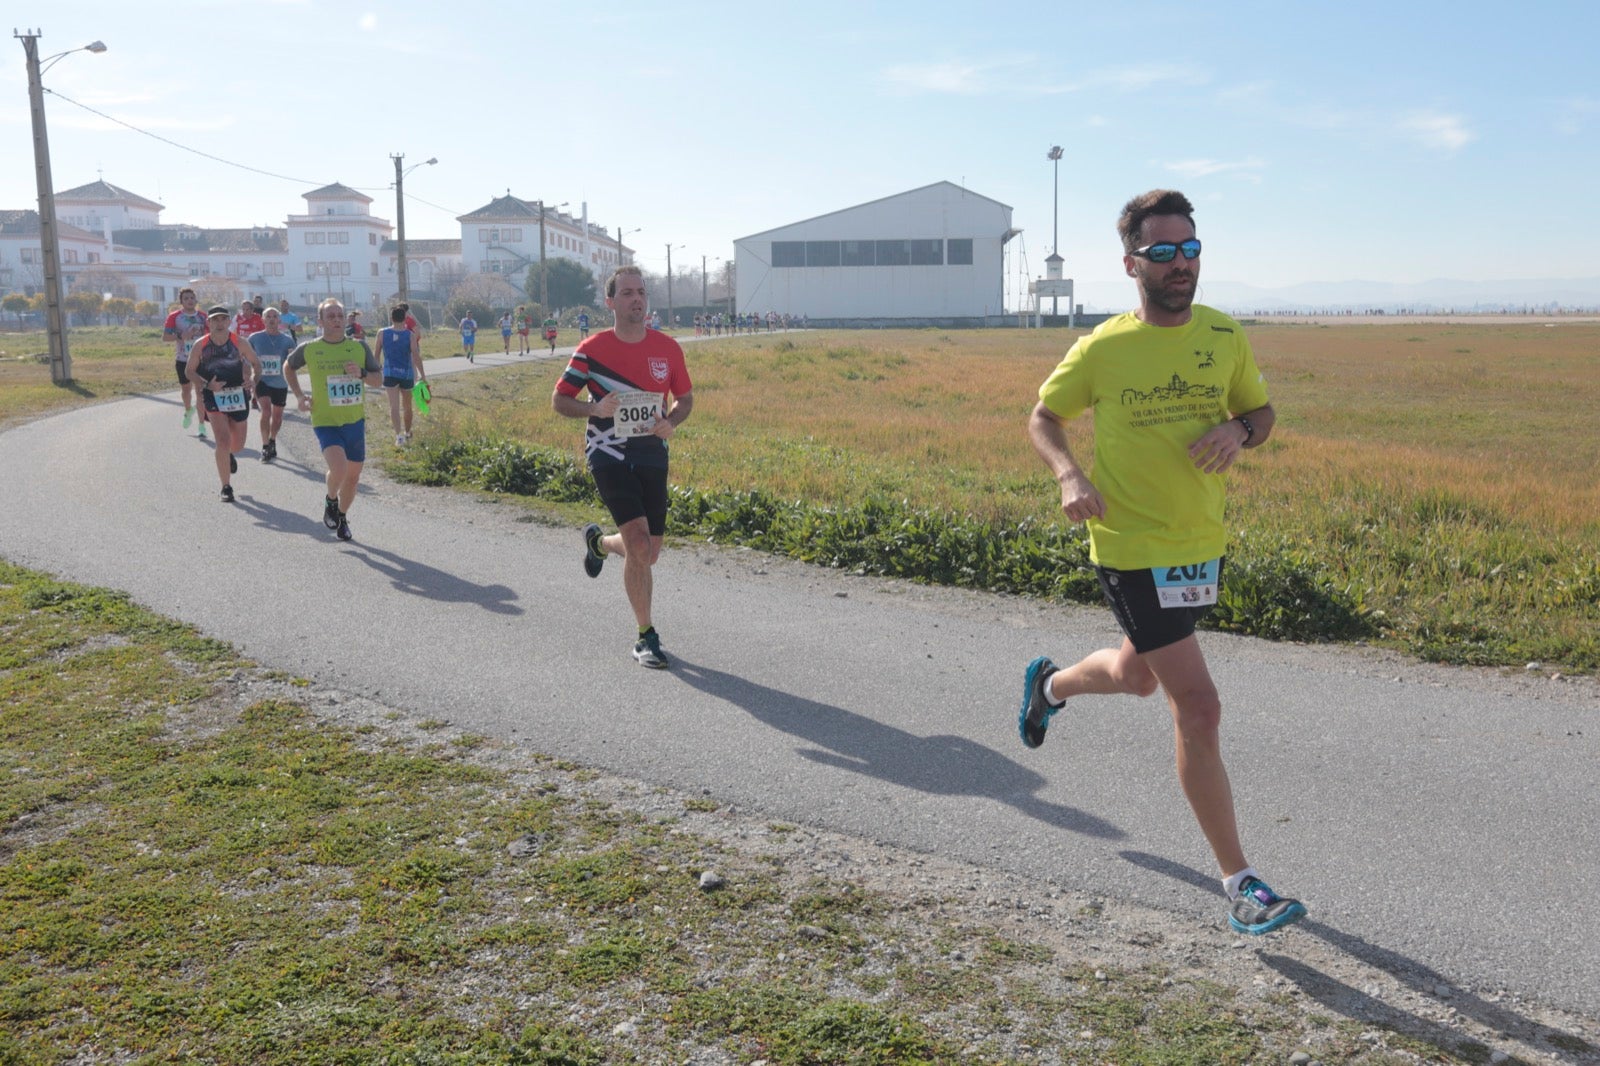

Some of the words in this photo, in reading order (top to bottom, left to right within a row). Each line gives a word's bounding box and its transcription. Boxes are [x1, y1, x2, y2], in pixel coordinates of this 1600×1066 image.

[330, 383, 361, 396] 1105
[220, 393, 240, 405] 710
[620, 404, 657, 422] 3084
[1143, 408, 1164, 417] GRAN
[1164, 405, 1187, 414] PREMIO
